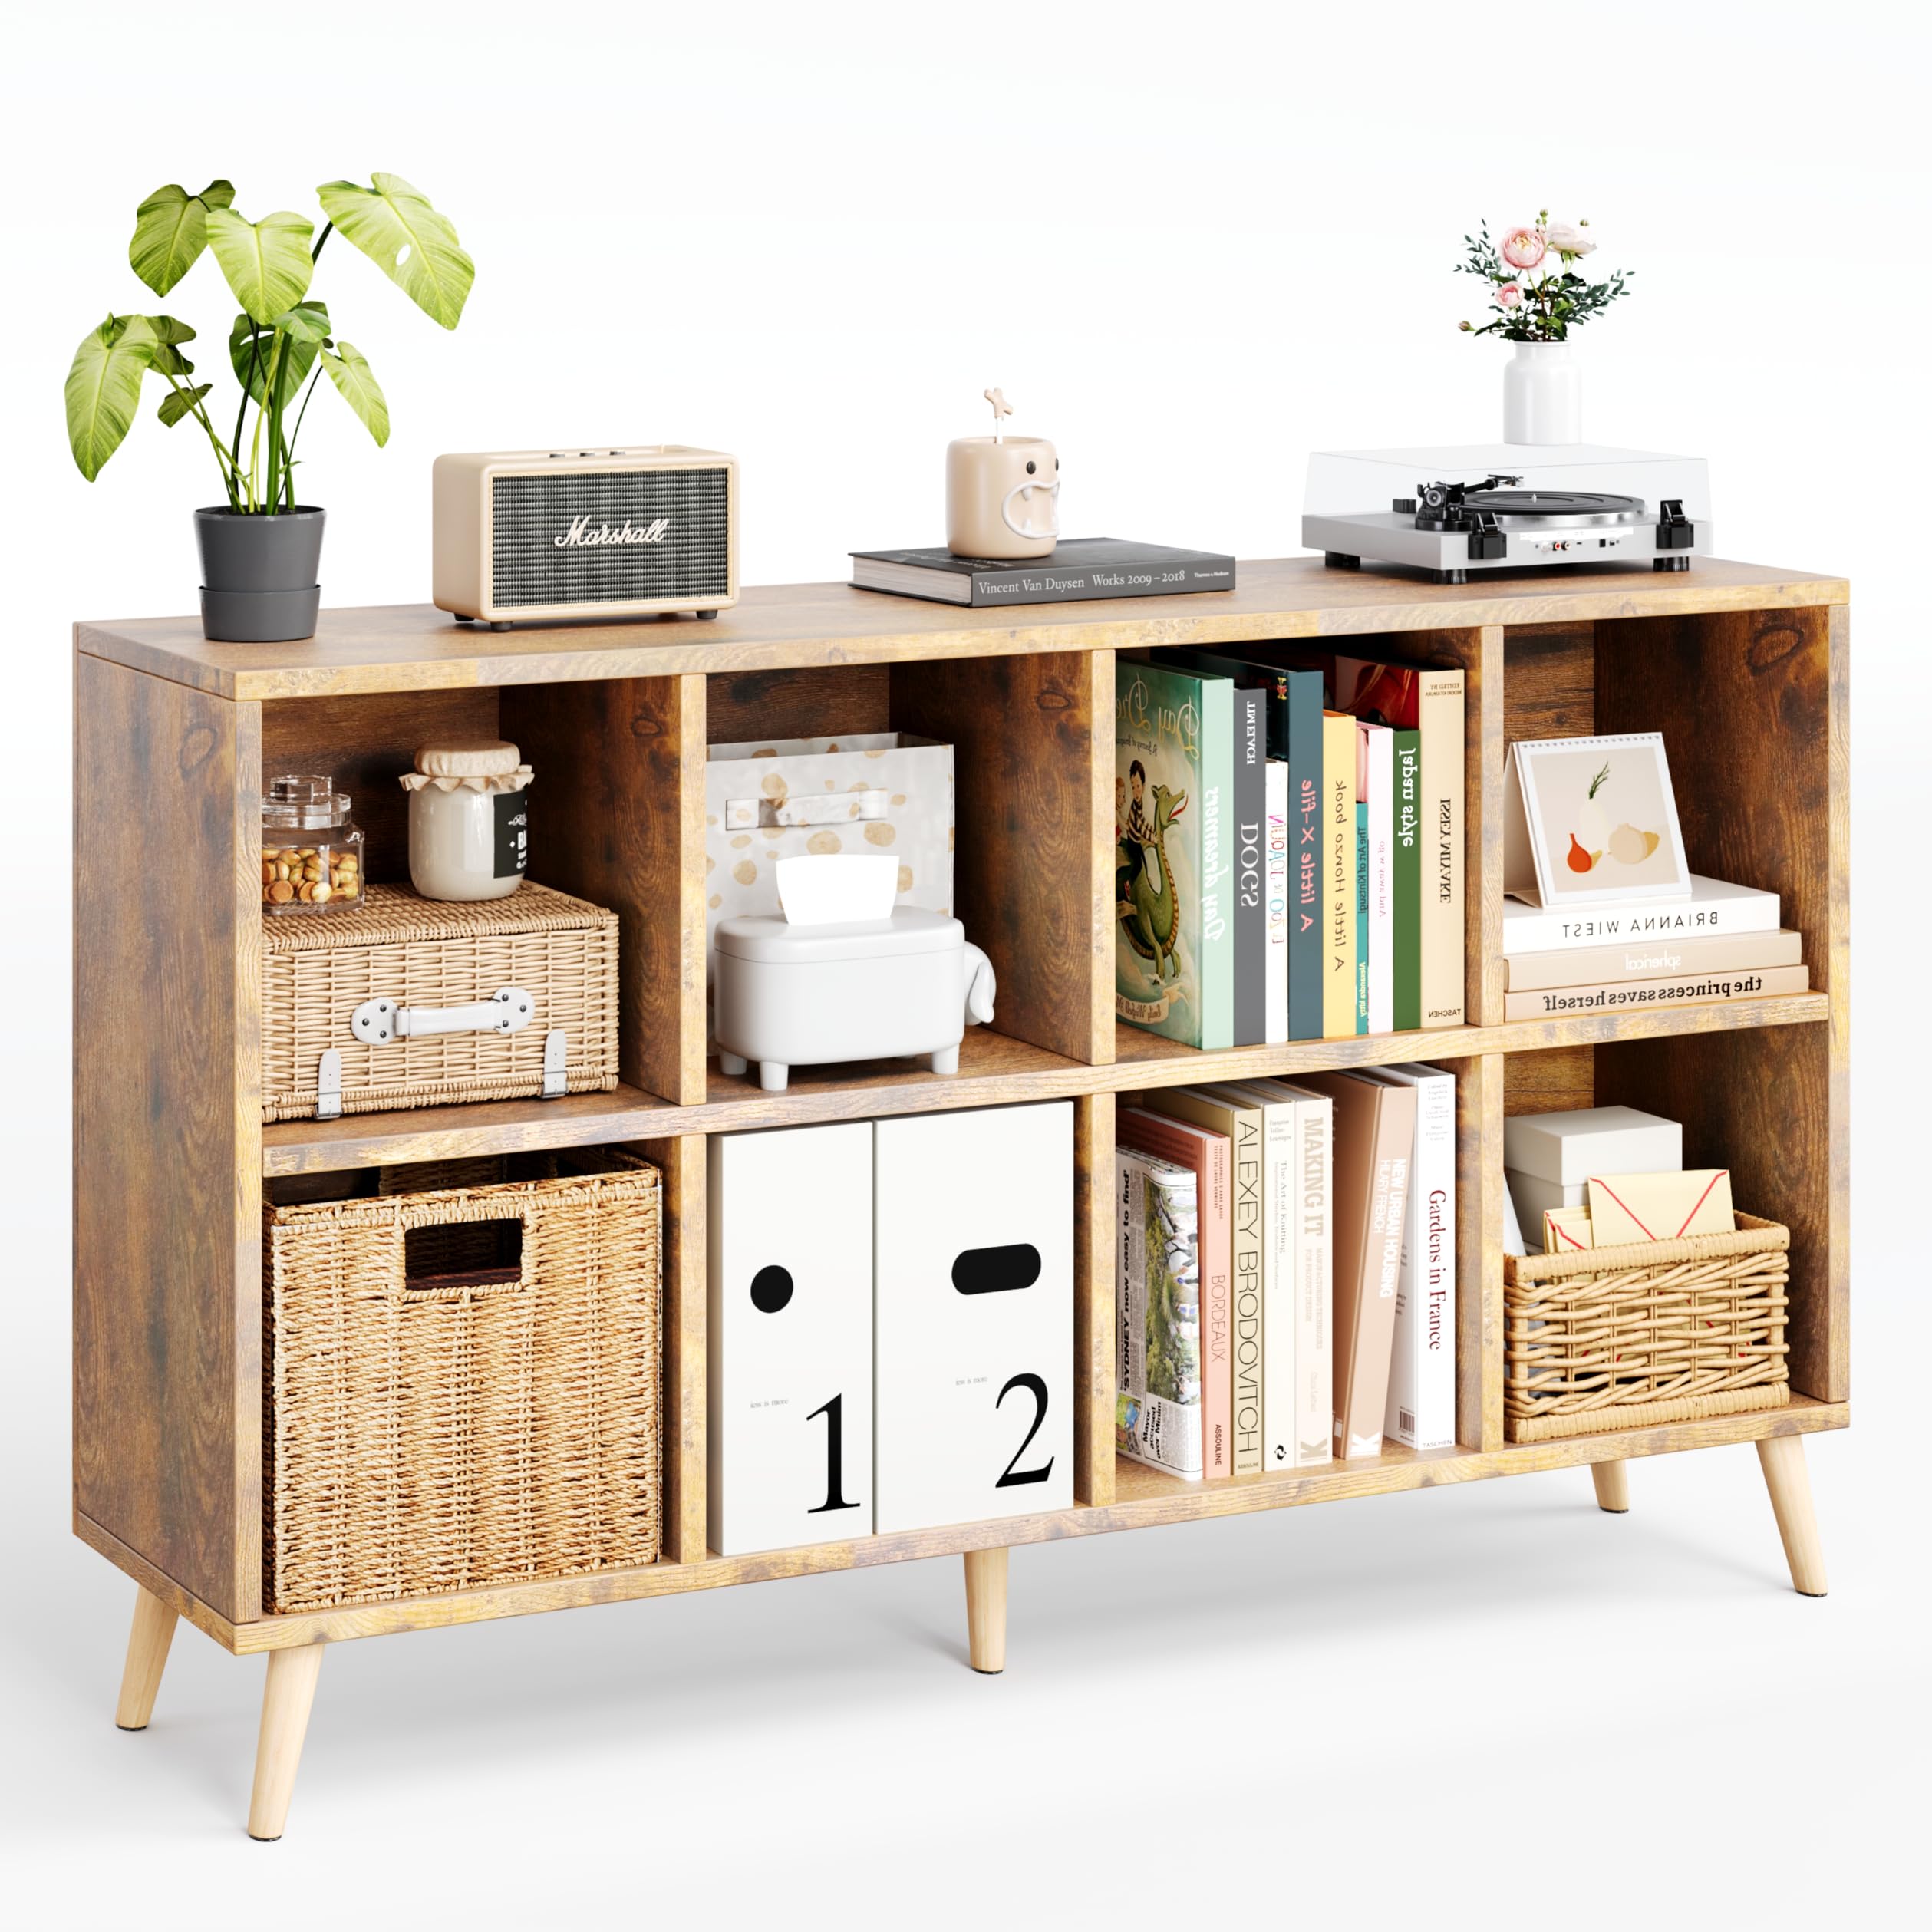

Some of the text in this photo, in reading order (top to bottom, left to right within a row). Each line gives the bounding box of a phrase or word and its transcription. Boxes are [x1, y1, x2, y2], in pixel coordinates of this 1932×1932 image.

[554, 515, 669, 548] Marshall
[978, 579, 1019, 595] Vincent
[1023, 579, 1042, 592] Van
[1045, 575, 1084, 592] Duysen
[1093, 572, 1125, 586] Works
[1128, 574, 1152, 587] 2009
[1162, 570, 1185, 583] 2018
[1304, 1116, 1324, 1236] MAKING IT
[1373, 1159, 1391, 1234] HILARY FRENCH
[1391, 1159, 1406, 1189] NEW
[1123, 1210, 1129, 1227] to
[1281, 1201, 1287, 1210] of
[1385, 1191, 1403, 1236] URBAN
[1279, 1213, 1287, 1254] Knitting
[1238, 1121, 1258, 1452] ALEXEY BRODOVITCH
[1379, 1238, 1398, 1298] HOUSING
[1429, 1190, 1446, 1350] Gardens in France
[1211, 1274, 1225, 1363] BORDEAUX
[806, 1393, 861, 1513] 1
[995, 1372, 1055, 1488] 2
[1423, 1439, 1452, 1448] TASCHEN
